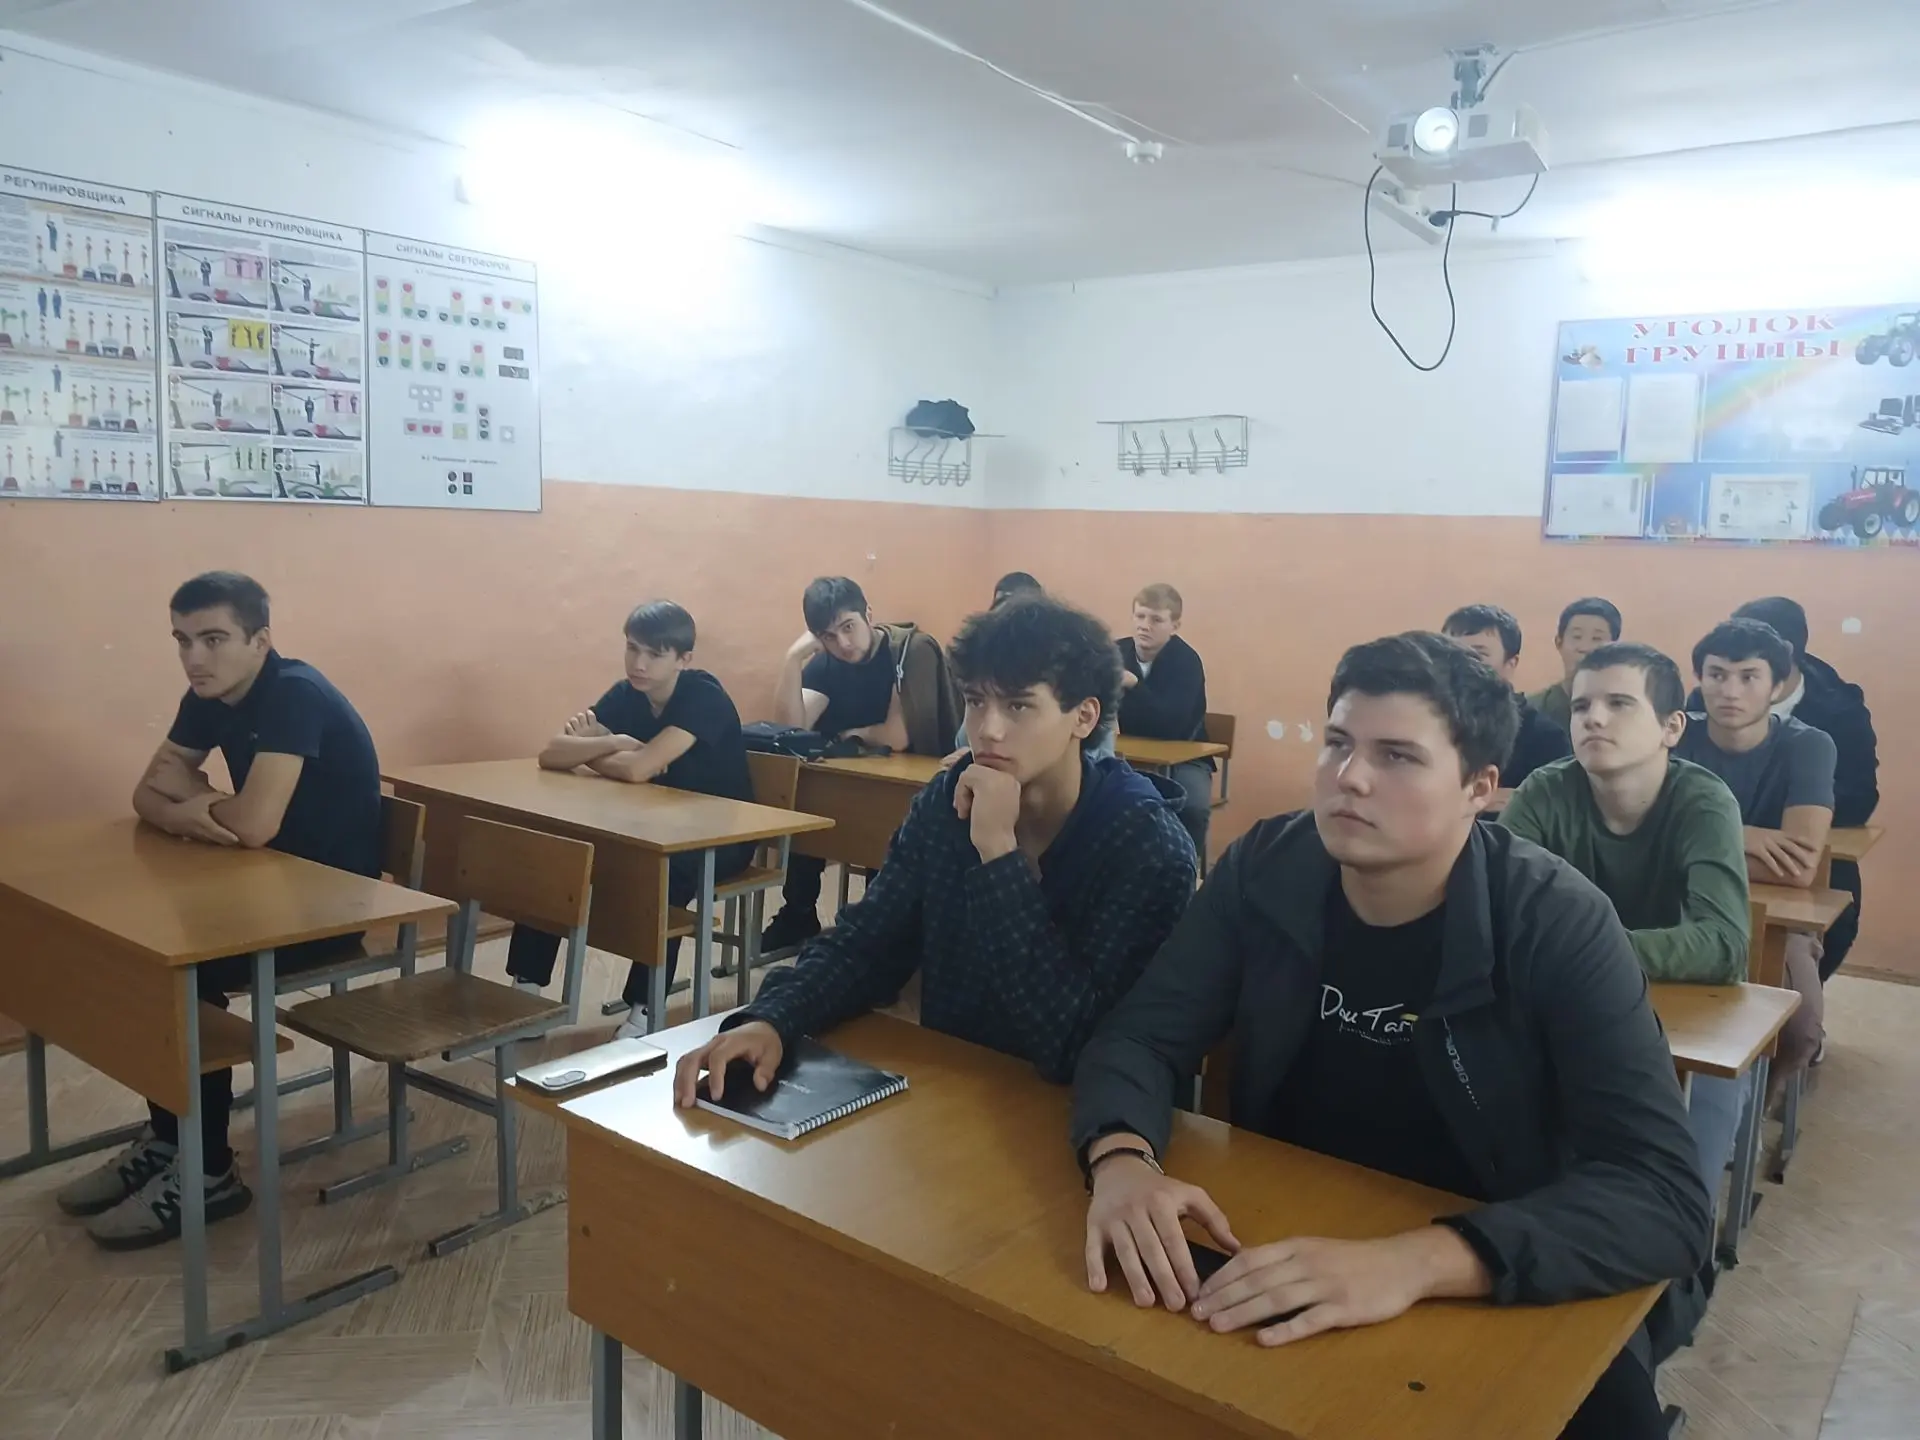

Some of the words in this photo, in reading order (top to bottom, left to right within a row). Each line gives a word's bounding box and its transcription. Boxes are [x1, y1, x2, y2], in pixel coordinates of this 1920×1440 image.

[4, 174, 126, 206] РЕГУЛИРОВЩИКА
[181, 205, 242, 224] СИГНАЛЫ
[248, 216, 343, 241] РЕГУЛИРОВЩИКА
[396, 243, 443, 260] СИГНАЛЫ
[1633, 314, 1835, 340] УГОЛОК
[1625, 339, 1841, 364] ГРУППЫ
